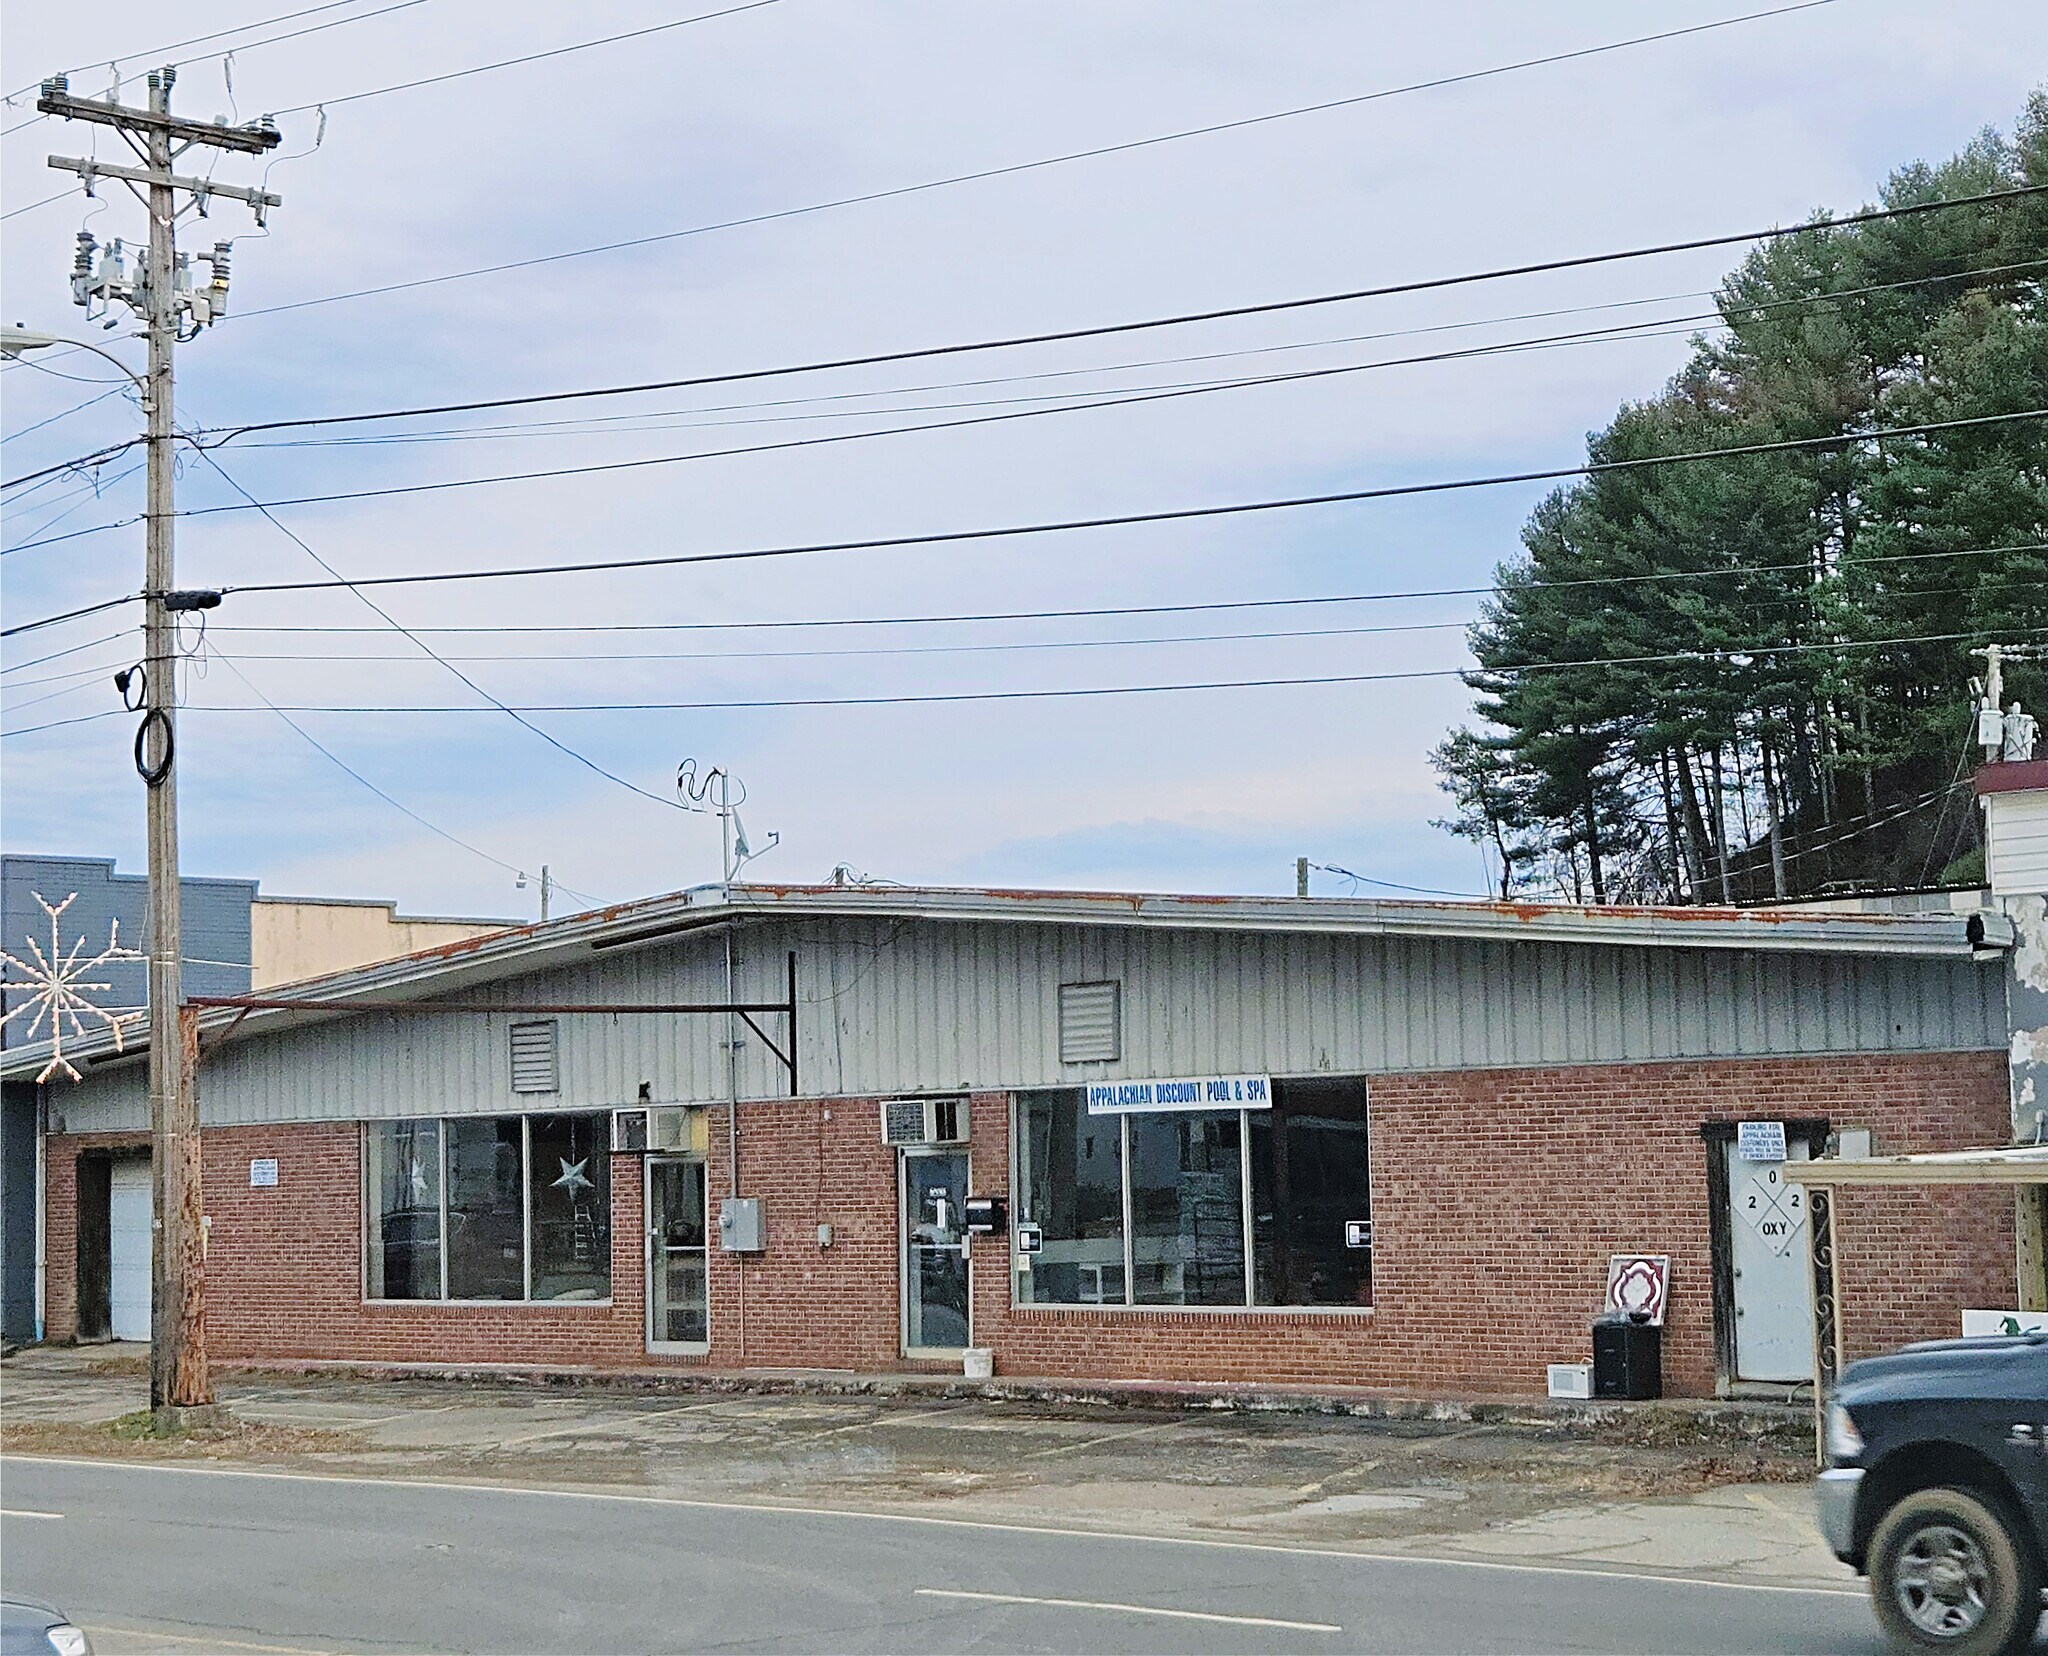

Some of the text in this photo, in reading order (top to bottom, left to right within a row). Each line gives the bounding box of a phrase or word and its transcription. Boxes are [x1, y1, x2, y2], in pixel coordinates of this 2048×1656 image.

[1090, 1079, 1267, 1106] APPALACHIAN DISCOUNT POOL & SPA
[1748, 1196, 1757, 1209] 2
[1791, 1194, 1800, 1208] 2
[1762, 1221, 1787, 1235] OXY
